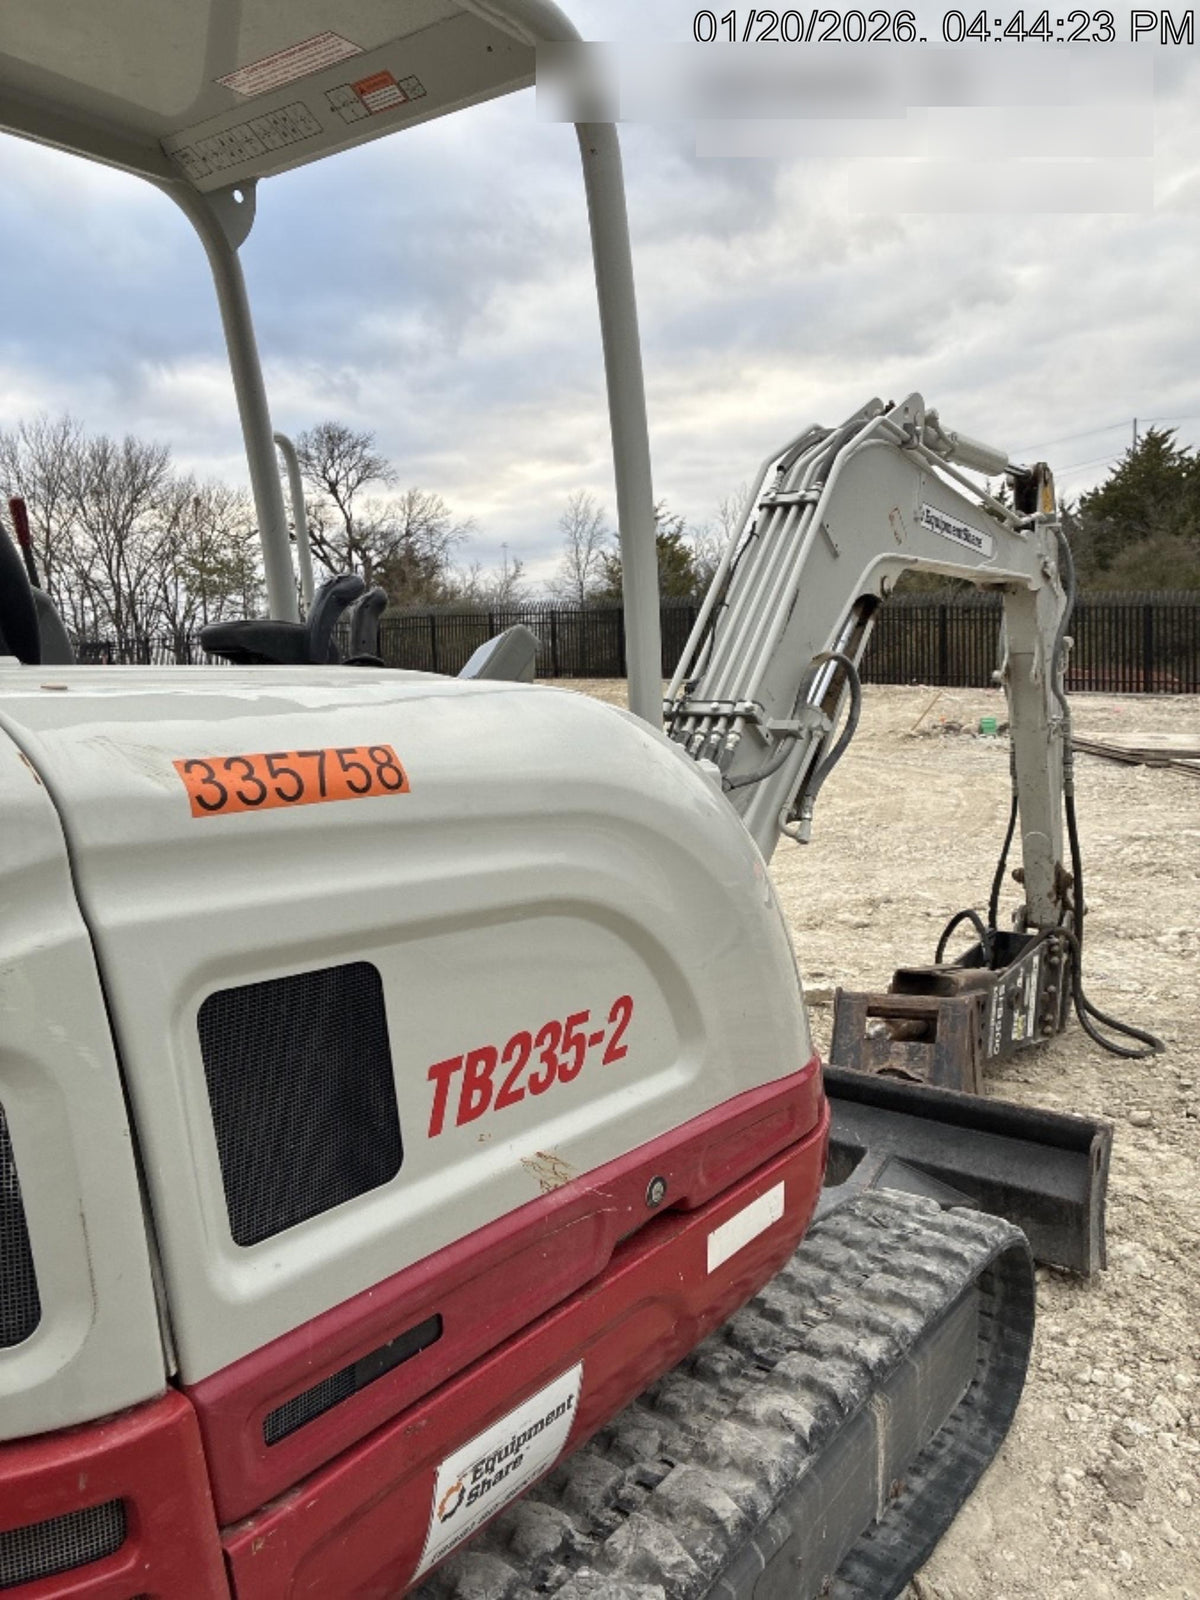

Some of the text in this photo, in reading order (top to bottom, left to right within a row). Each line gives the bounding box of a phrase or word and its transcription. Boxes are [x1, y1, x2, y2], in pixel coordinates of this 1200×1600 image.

[184, 747, 404, 811] 335758
[427, 995, 634, 1138] TB235-2
[470, 1393, 574, 1485] Equipment
[466, 1453, 523, 1507] Share
